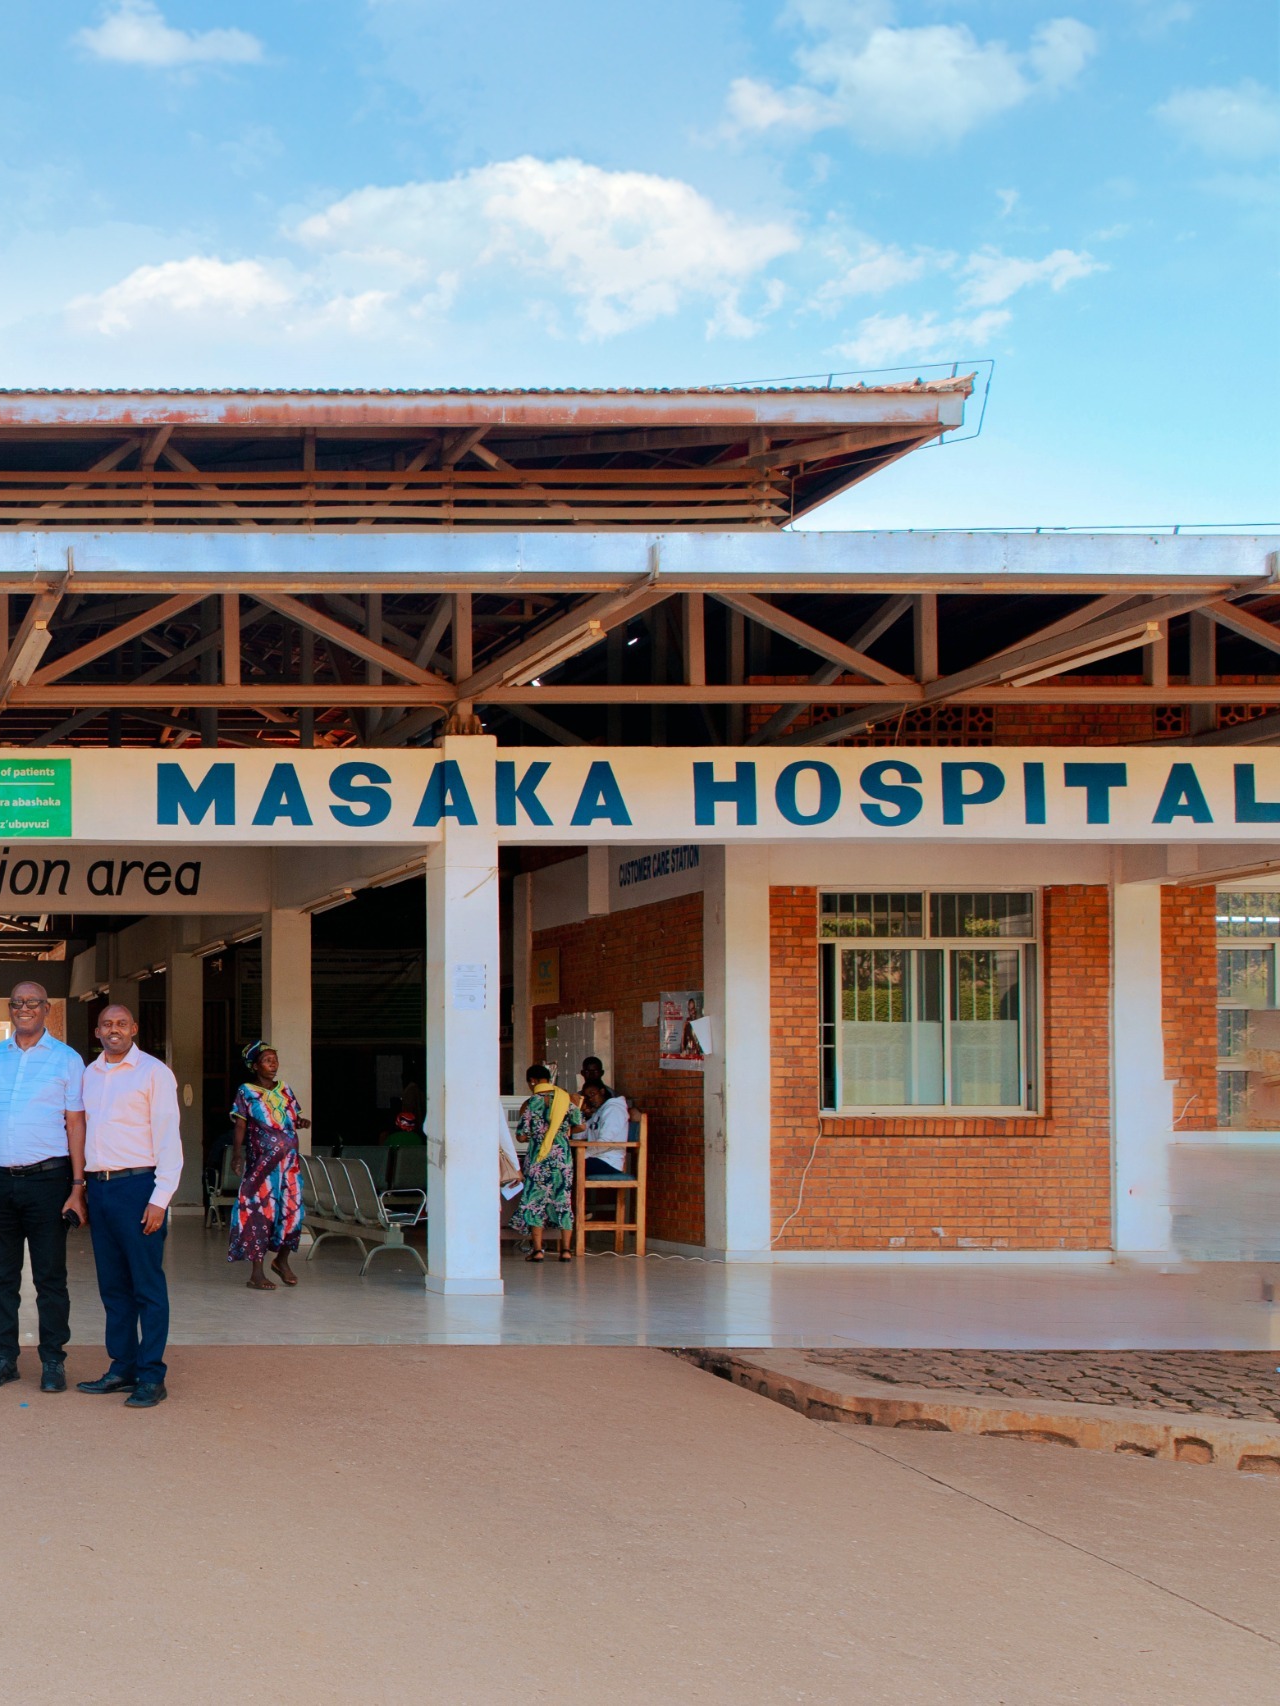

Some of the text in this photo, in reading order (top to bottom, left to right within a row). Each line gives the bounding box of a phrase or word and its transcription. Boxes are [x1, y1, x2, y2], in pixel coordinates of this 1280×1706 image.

[1, 767, 11, 776] of
[14, 767, 55, 778] patients
[12, 797, 61, 806] abashaka
[157, 760, 1280, 827] MASAKA HOSPITAL
[0, 820, 49, 829] z'ubuvuzi
[619, 845, 700, 887] CUSTOMER CARE STATION
[87, 861, 201, 896] area
